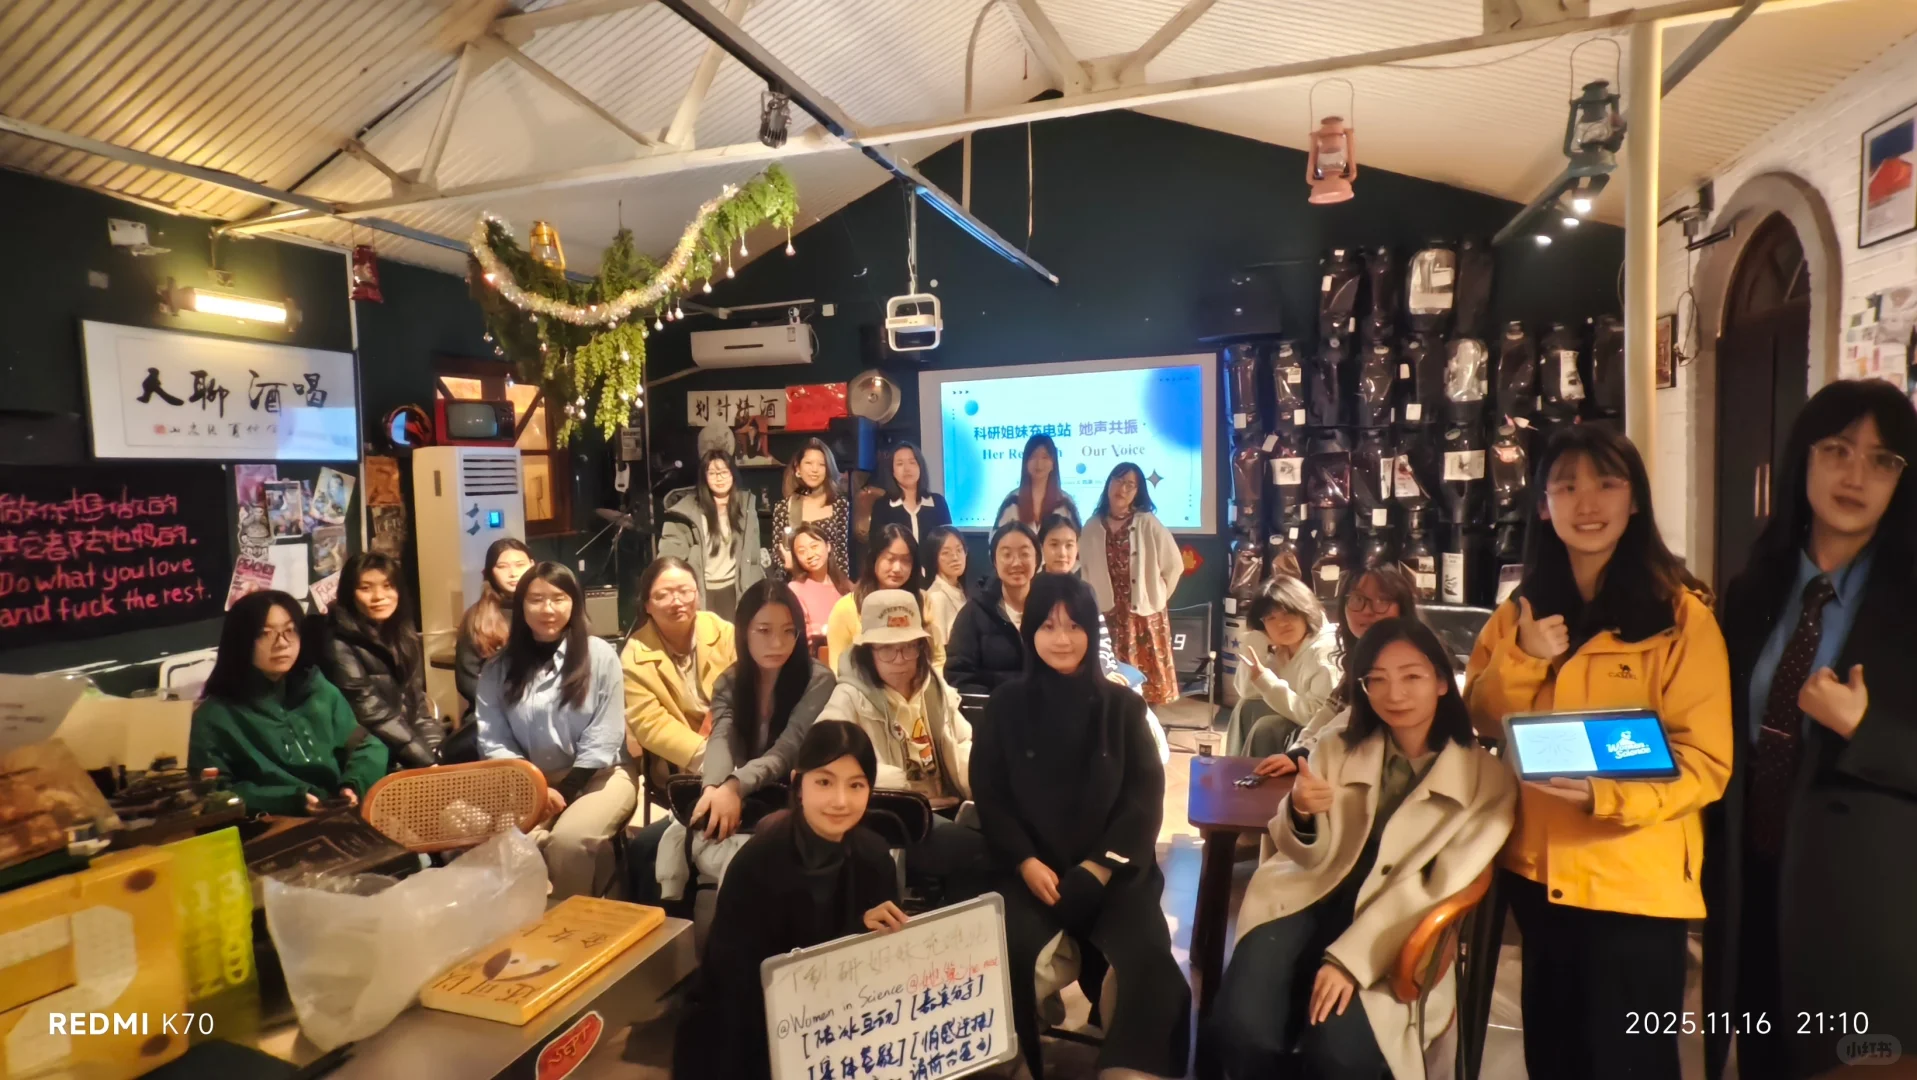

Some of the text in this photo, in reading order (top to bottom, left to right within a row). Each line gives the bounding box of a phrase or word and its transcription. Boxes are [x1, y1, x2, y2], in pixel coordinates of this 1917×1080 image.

[1079, 419, 1138, 436] 她声共振
[982, 448, 1004, 460] Her
[1081, 443, 1145, 457] Our Voice
[0, 557, 194, 596] Do what you love
[0, 595, 51, 627] and
[57, 594, 118, 621] fuck
[121, 588, 158, 611] the
[163, 578, 212, 604] rest.
[777, 1004, 835, 1039] @Women
[843, 1002, 853, 1012] in
[858, 983, 904, 1008] Science
